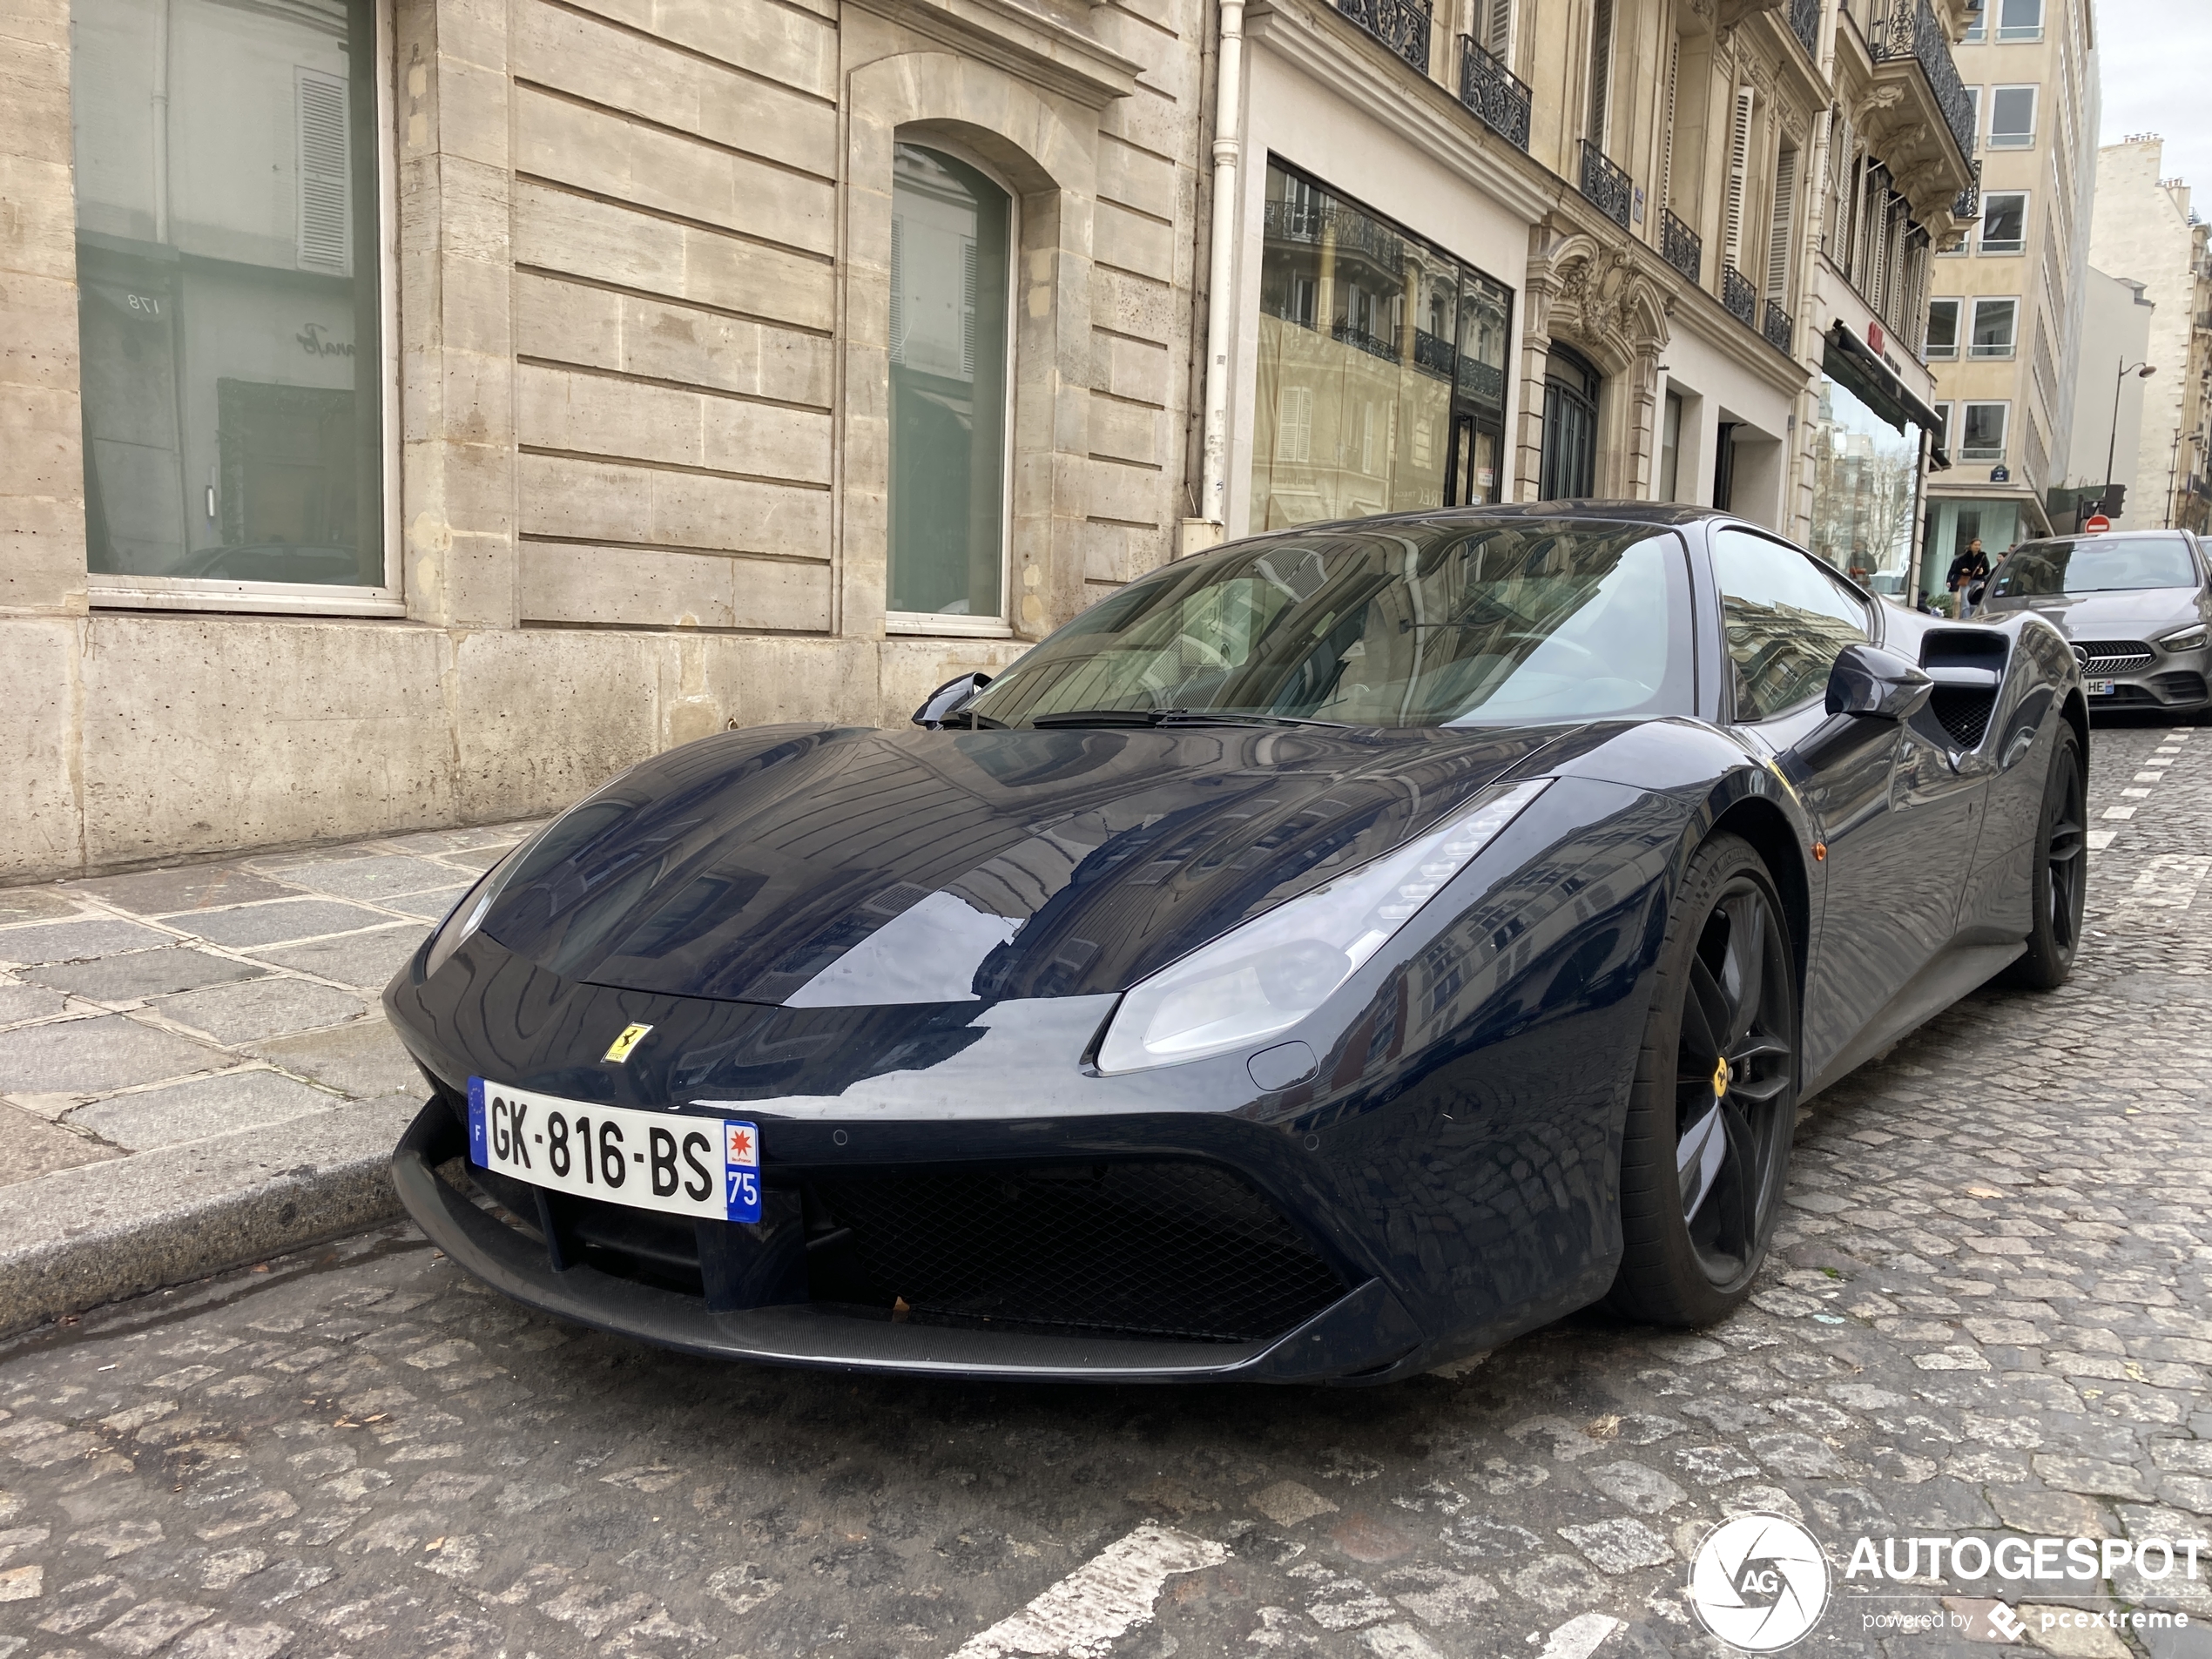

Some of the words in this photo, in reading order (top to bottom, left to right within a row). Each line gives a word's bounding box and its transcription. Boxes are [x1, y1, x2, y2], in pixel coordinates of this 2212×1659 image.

[475, 1124, 481, 1141] F
[491, 1096, 713, 1203] GK-816-BS
[728, 1171, 758, 1205] 75
